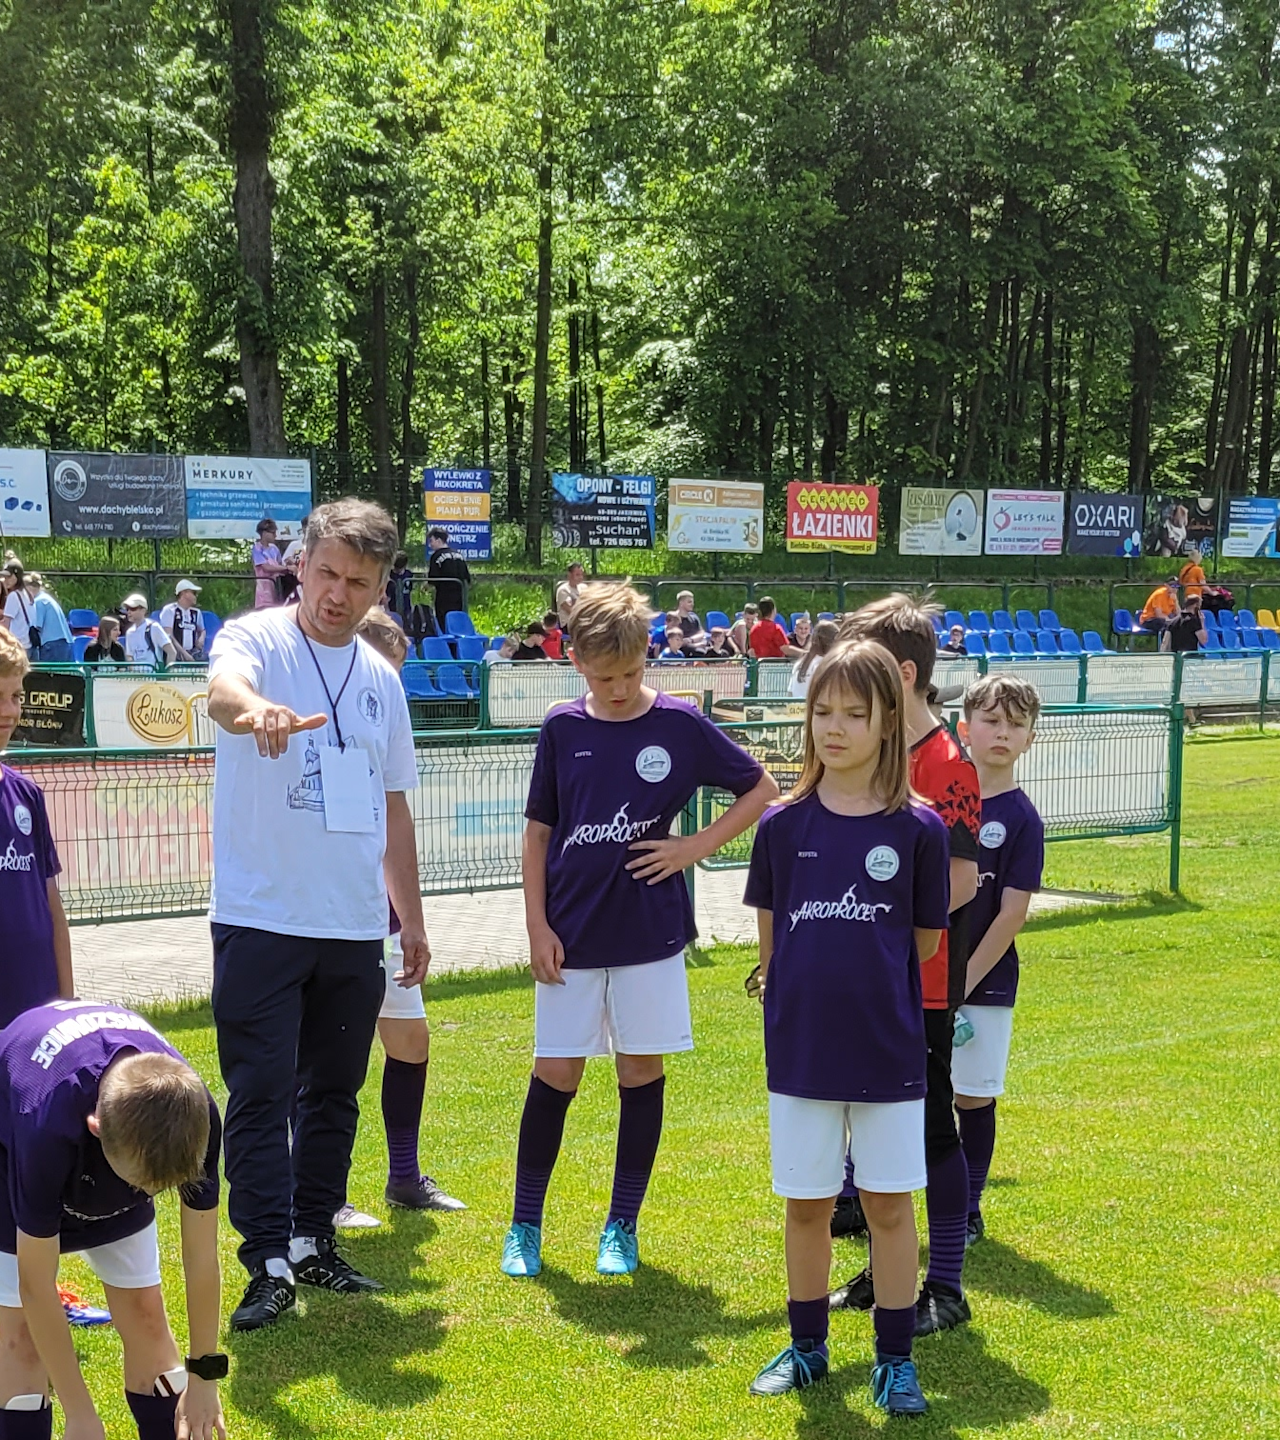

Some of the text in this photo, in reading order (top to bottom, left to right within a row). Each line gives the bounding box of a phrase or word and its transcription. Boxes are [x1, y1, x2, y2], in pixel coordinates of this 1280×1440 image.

[193, 469, 253, 480] MERKURY
[434, 471, 482, 480] WYLEWKI Z
[434, 480, 484, 490] MIXOKRETA
[576, 478, 614, 493] OPONY
[622, 480, 652, 494] FELGI
[433, 495, 483, 505] OCIEPLENIE
[78, 505, 164, 516] www.dachybielsko.pl
[463, 507, 480, 516] PUR
[1075, 504, 1135, 528] OXARI
[695, 515, 718, 524] STACJA
[792, 512, 873, 538] ŁAZIENKI
[30, 692, 73, 708] GROUP
